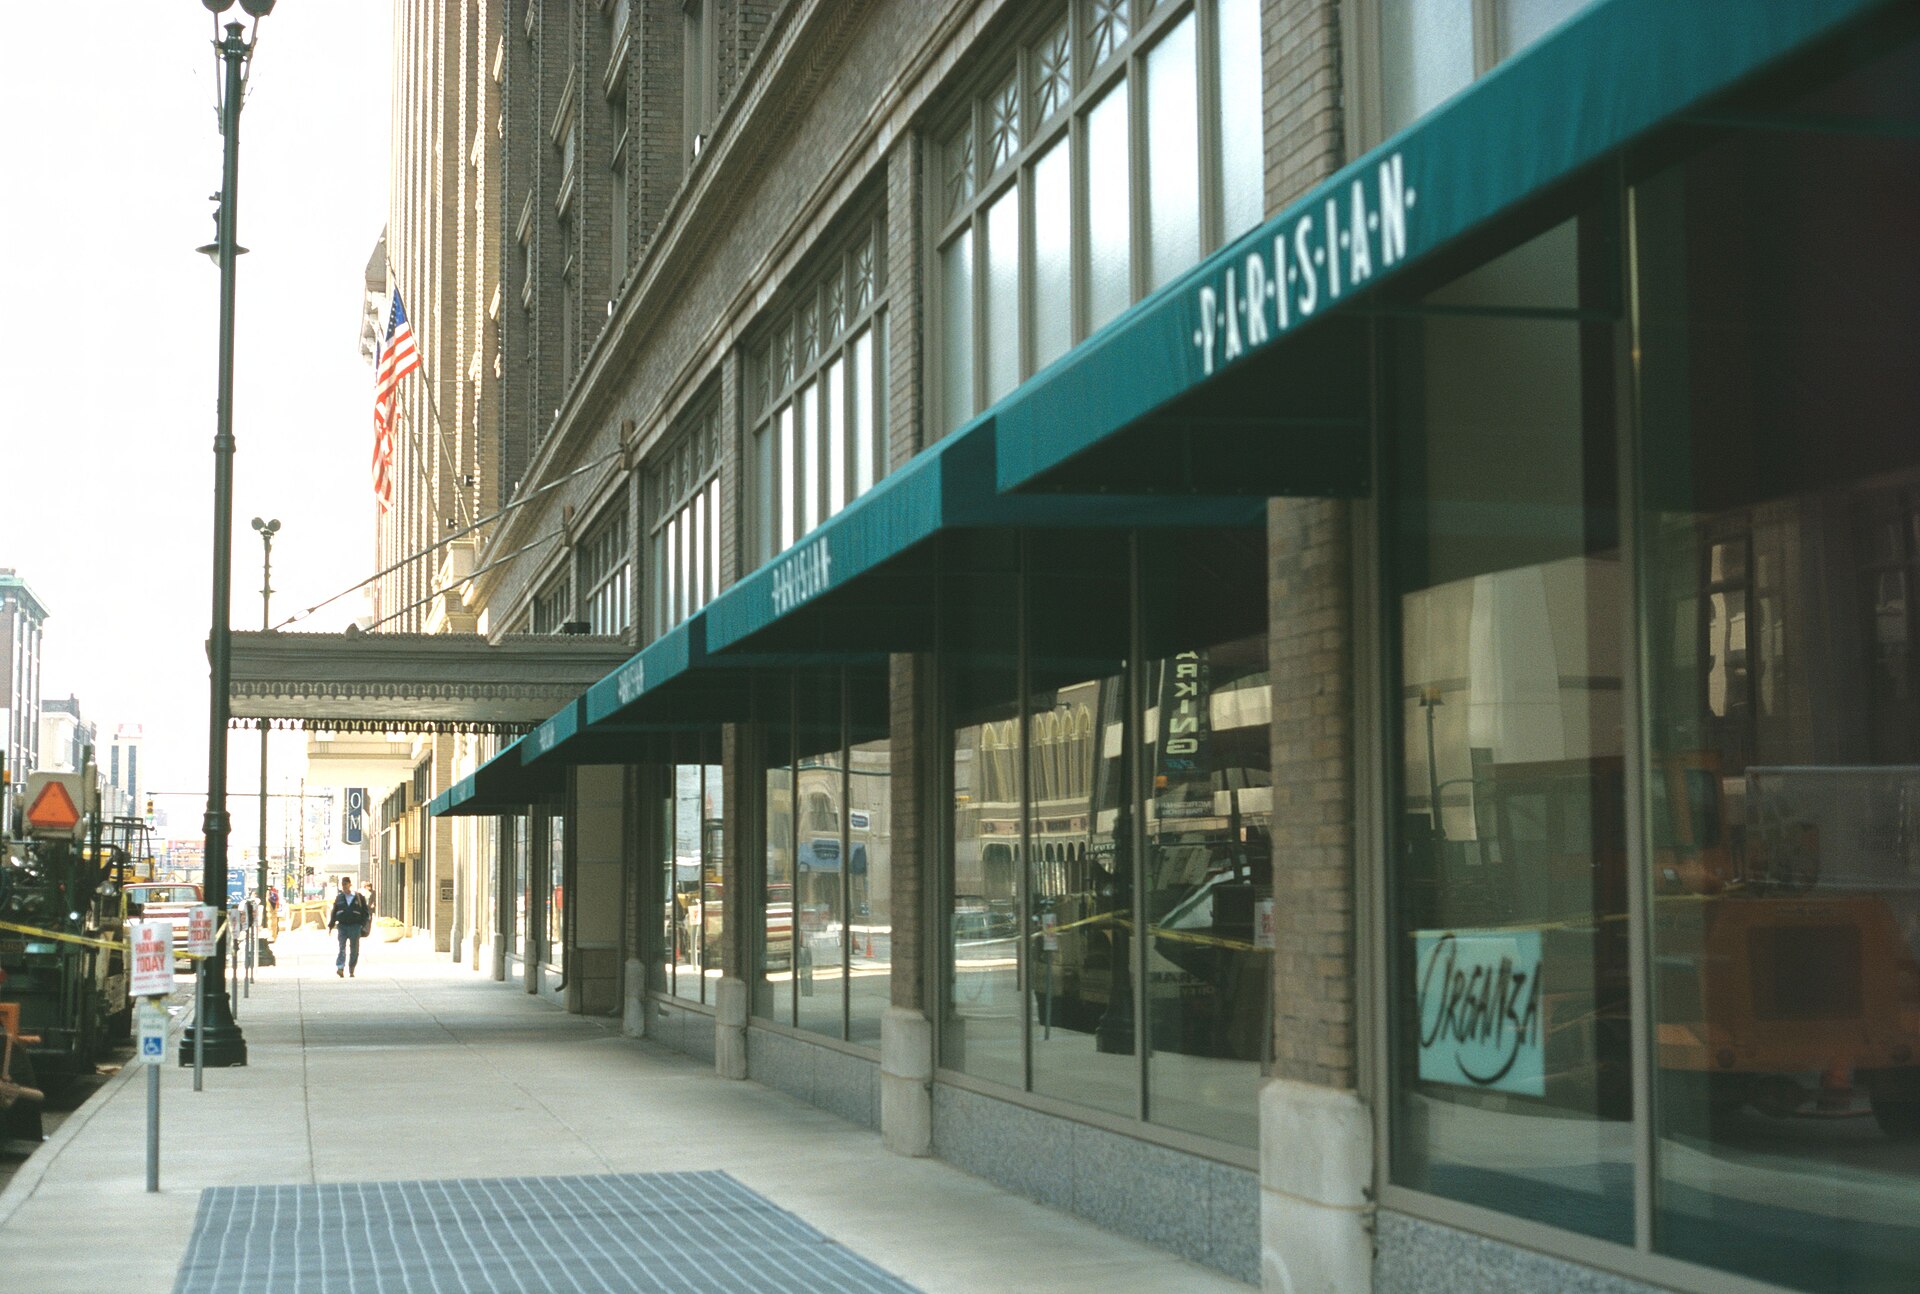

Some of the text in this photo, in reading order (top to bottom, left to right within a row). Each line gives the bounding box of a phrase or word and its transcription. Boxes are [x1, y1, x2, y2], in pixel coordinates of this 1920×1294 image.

[191, 920, 211, 929] PARKING
[142, 929, 151, 940] NO
[191, 930, 211, 940] TODAY
[135, 941, 165, 953] PARKING
[136, 956, 165, 973] TODAY
